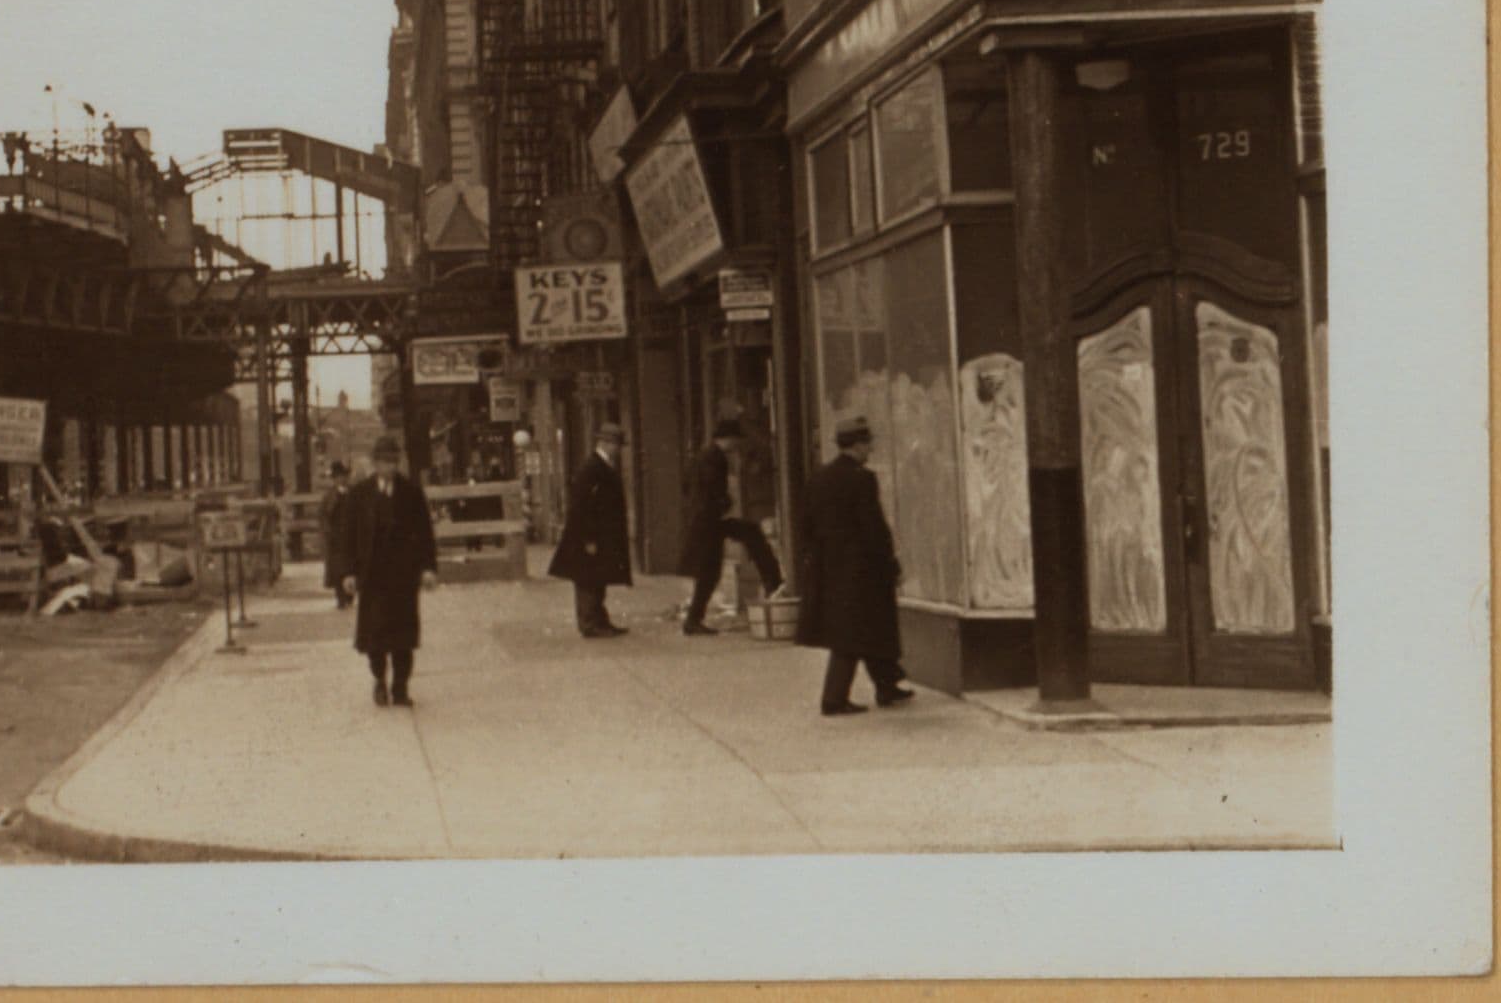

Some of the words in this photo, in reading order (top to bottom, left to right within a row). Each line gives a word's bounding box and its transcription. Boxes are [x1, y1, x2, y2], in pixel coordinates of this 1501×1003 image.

[1196, 129, 1251, 161] 729
[530, 268, 608, 289] KEYS
[528, 292, 551, 325] 2
